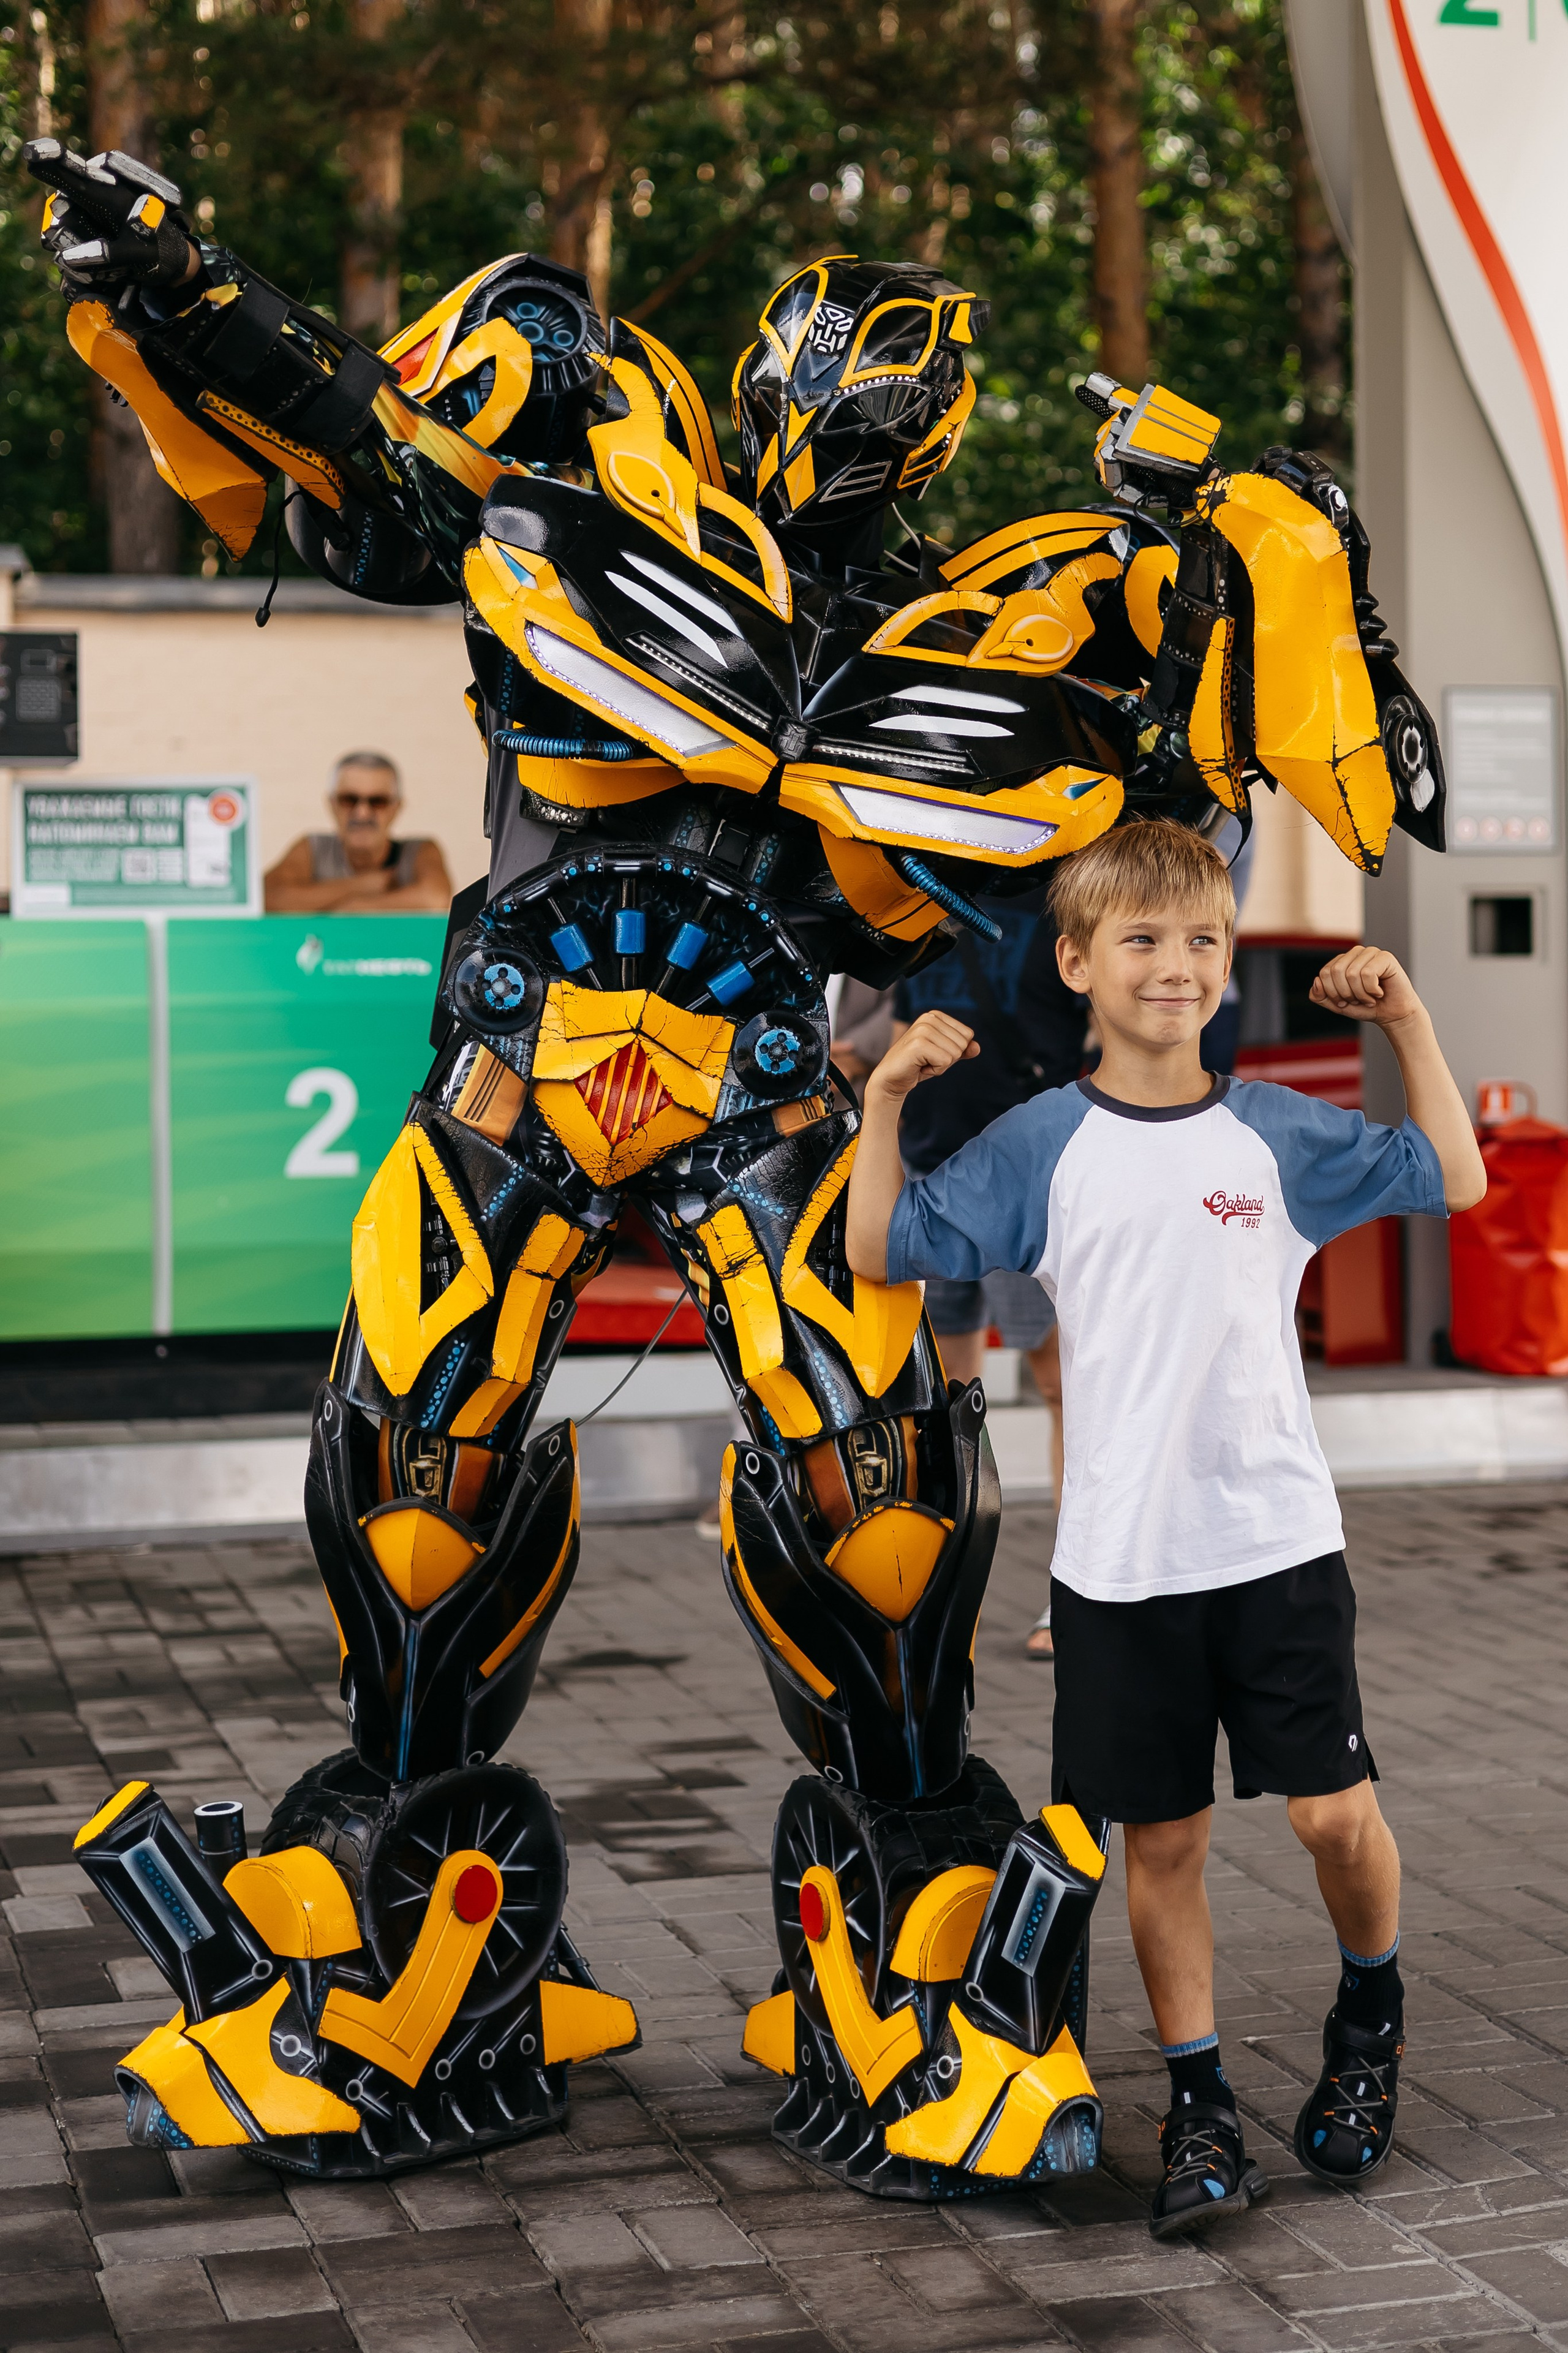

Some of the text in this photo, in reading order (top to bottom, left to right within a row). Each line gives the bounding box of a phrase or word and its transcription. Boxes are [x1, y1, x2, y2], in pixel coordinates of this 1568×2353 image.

[285, 1067, 359, 1178] 2
[1203, 1190, 1265, 1225] Oakland
[1241, 1217, 1260, 1228] 1992
